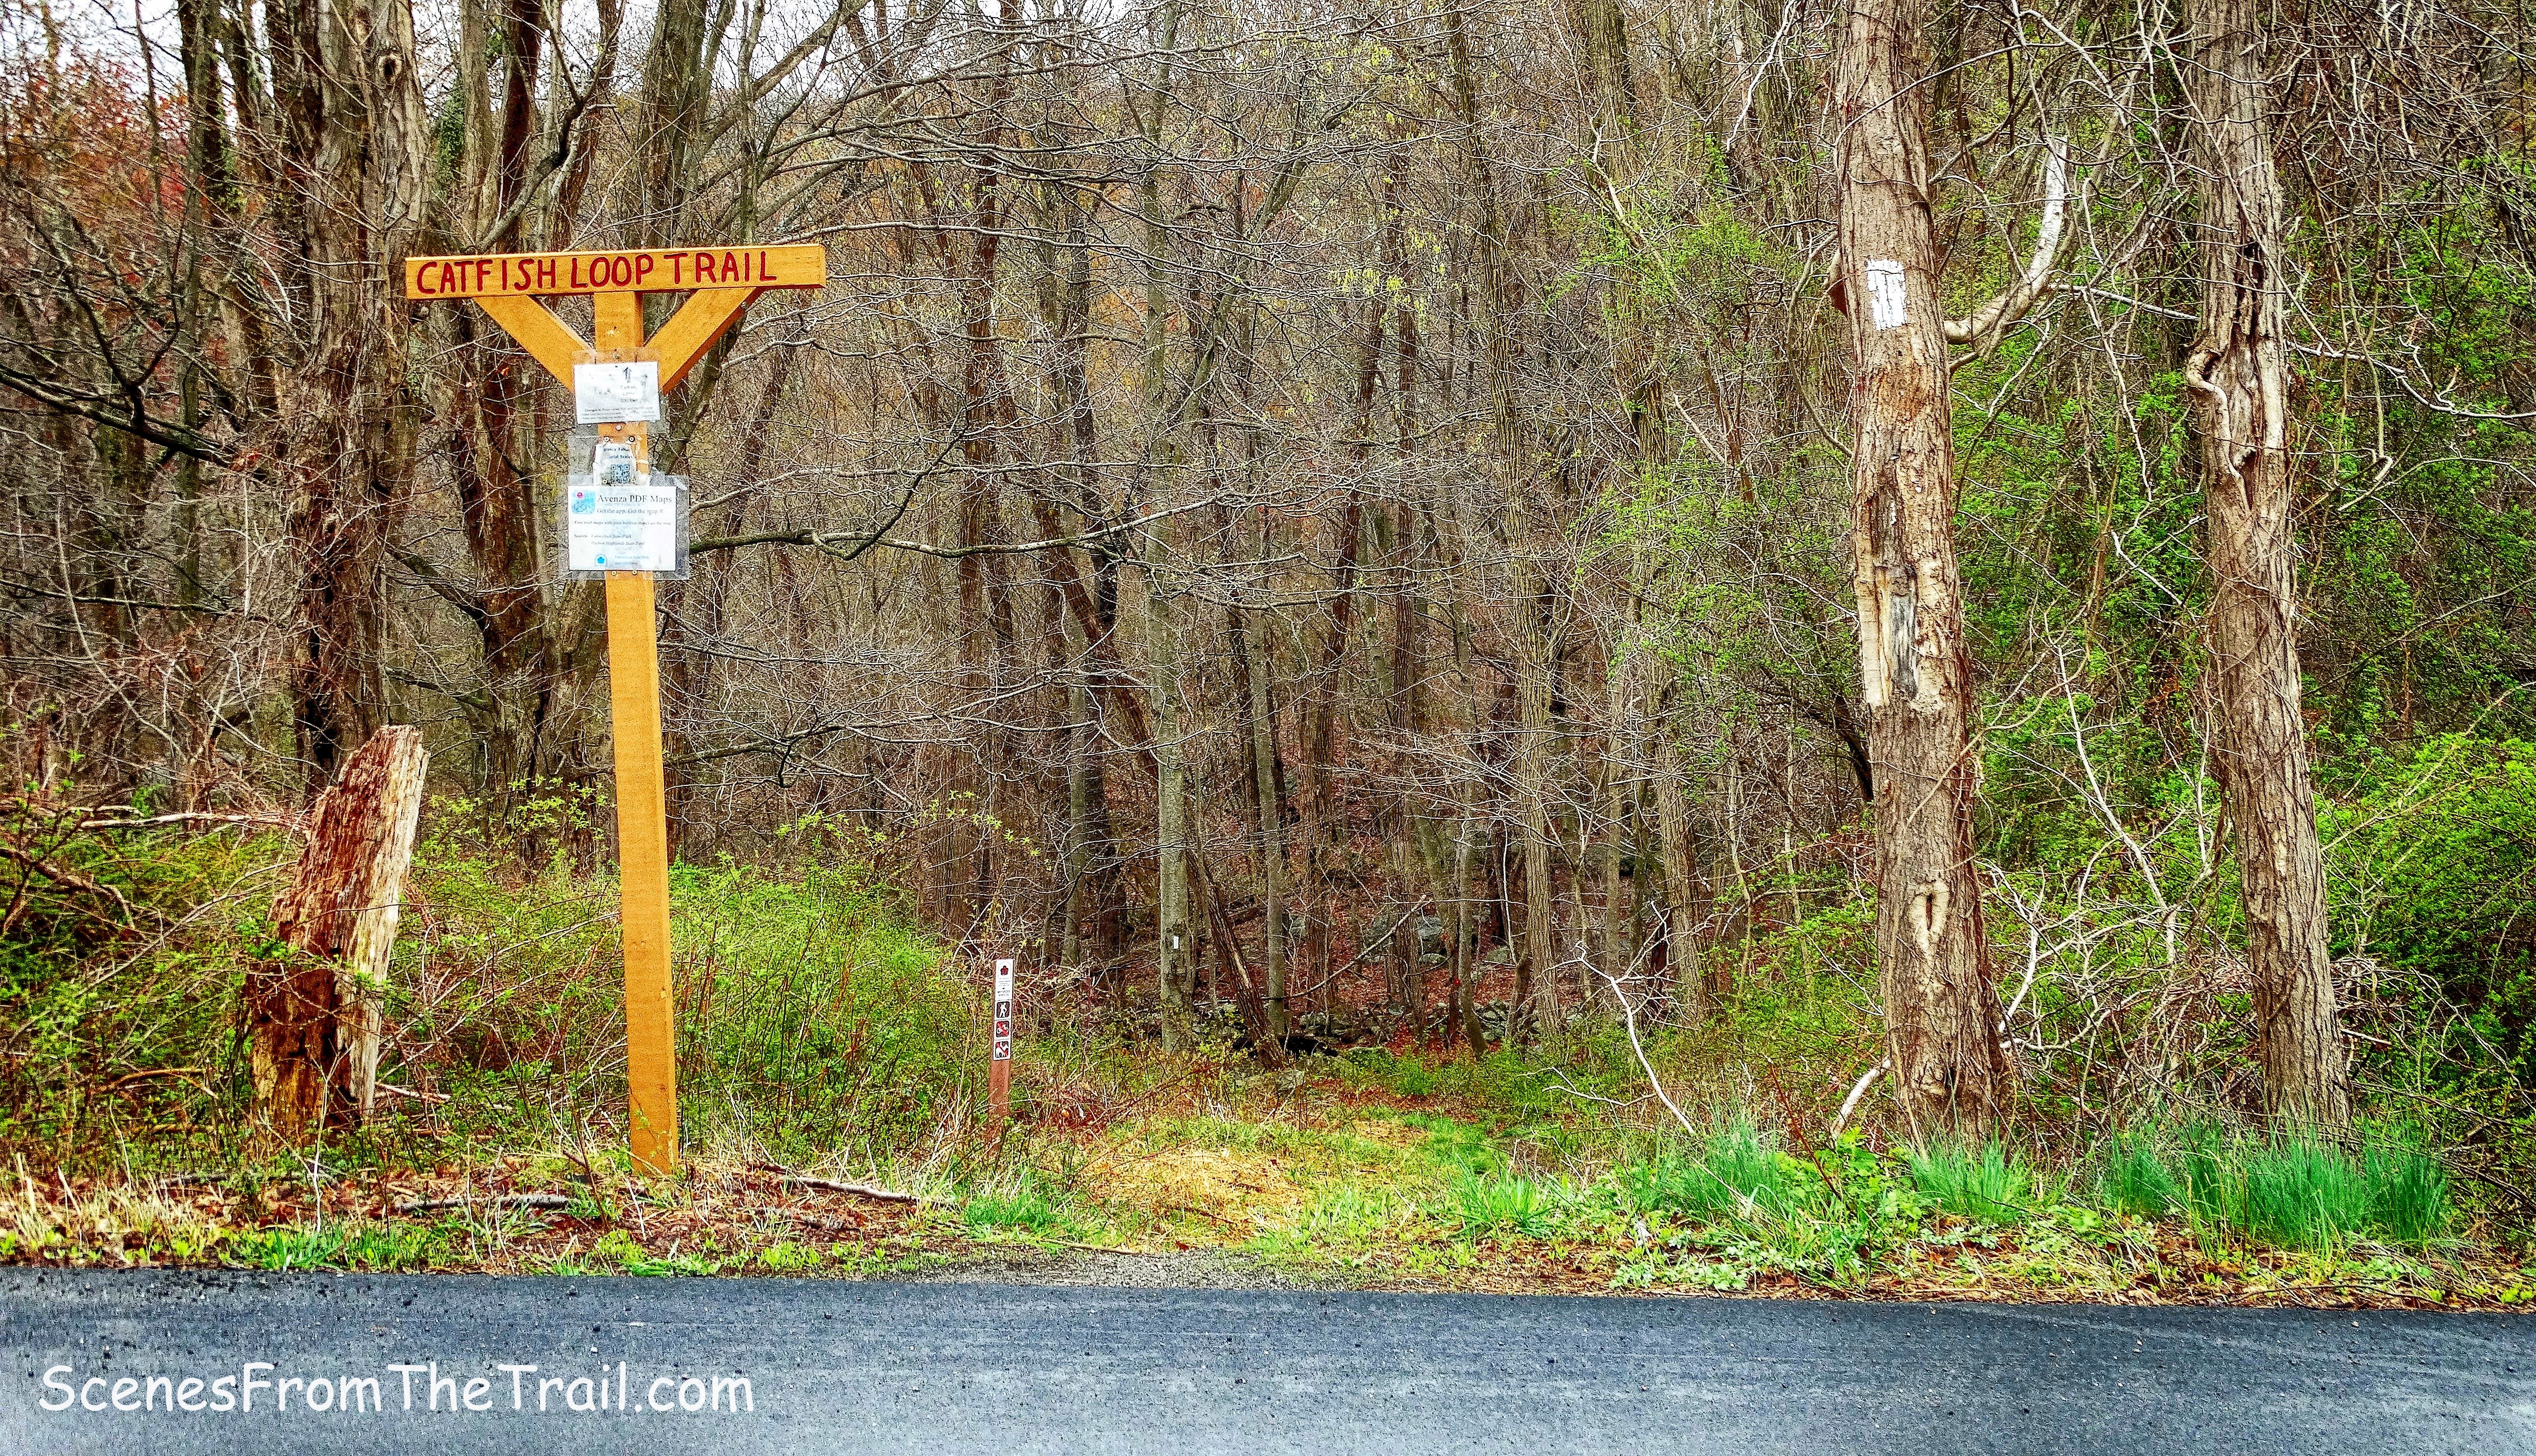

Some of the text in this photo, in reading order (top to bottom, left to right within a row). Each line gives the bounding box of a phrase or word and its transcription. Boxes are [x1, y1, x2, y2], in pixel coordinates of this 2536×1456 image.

[416, 251, 777, 295] CATFISH LOOP TRAIL
[650, 495, 672, 504] Maps
